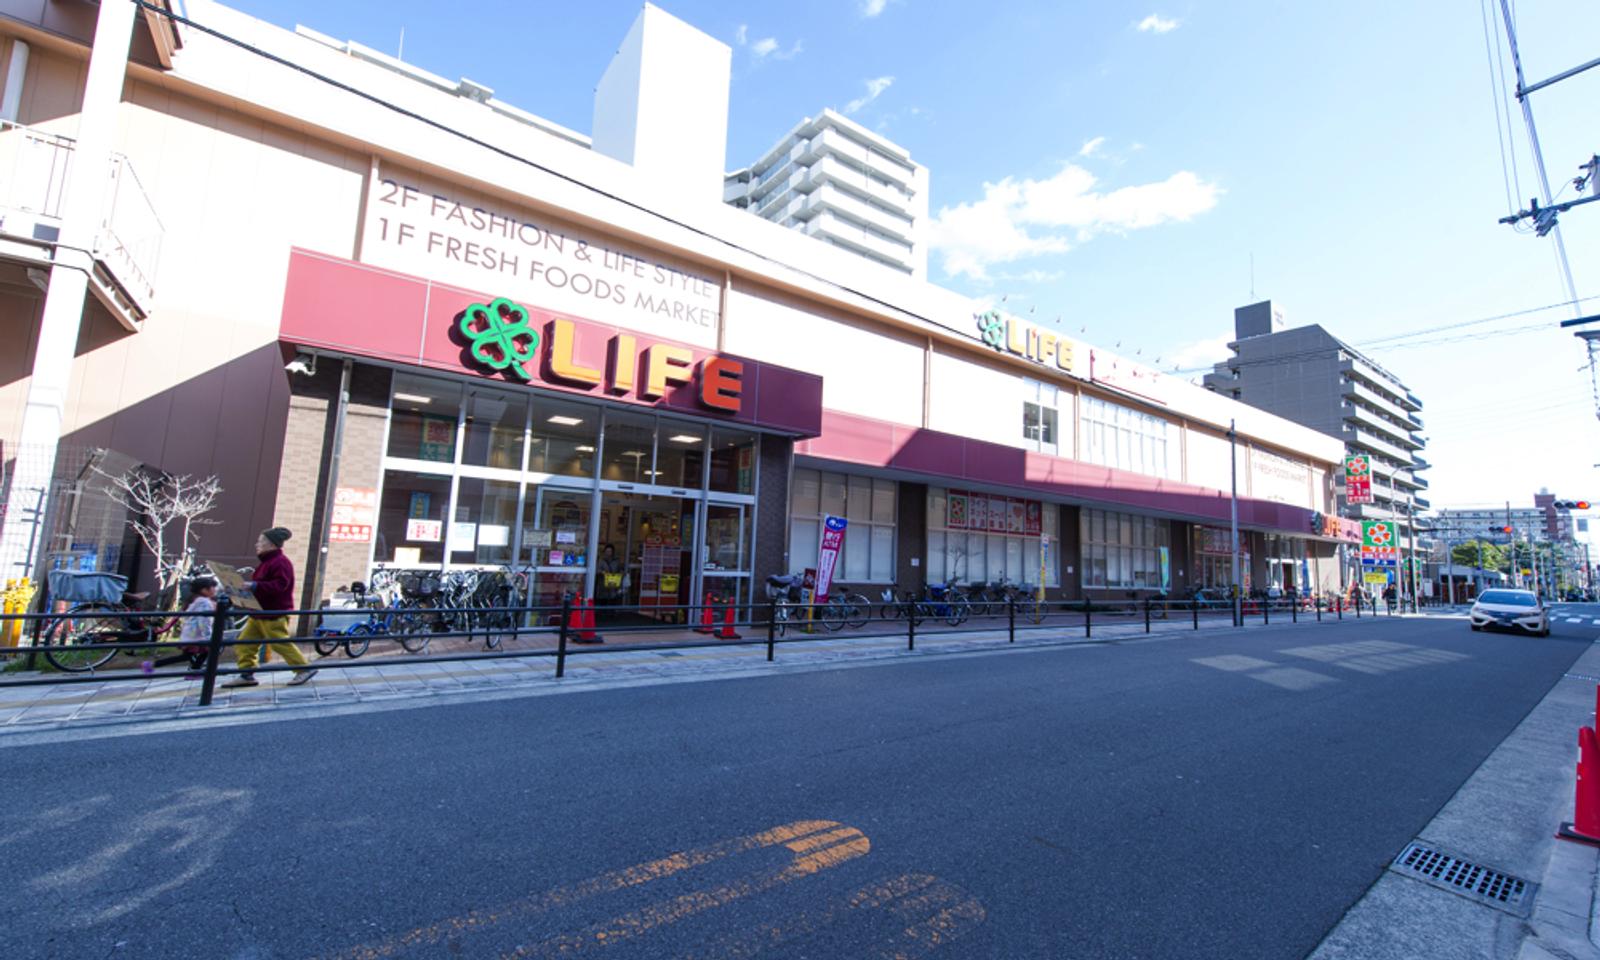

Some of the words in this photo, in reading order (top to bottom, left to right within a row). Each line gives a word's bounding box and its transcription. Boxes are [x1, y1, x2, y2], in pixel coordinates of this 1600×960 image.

[379, 179, 419, 208] 2F
[430, 194, 565, 255] FASHION
[574, 239, 592, 263] &
[603, 248, 646, 279] LIFE
[653, 263, 713, 299] STYLE
[379, 217, 416, 246] 1F
[427, 231, 519, 277] FRESH
[529, 260, 627, 304] FOODS
[633, 291, 721, 329] MARKET
[545, 319, 744, 412] LIFE
[1006, 319, 1073, 372] LIFE
